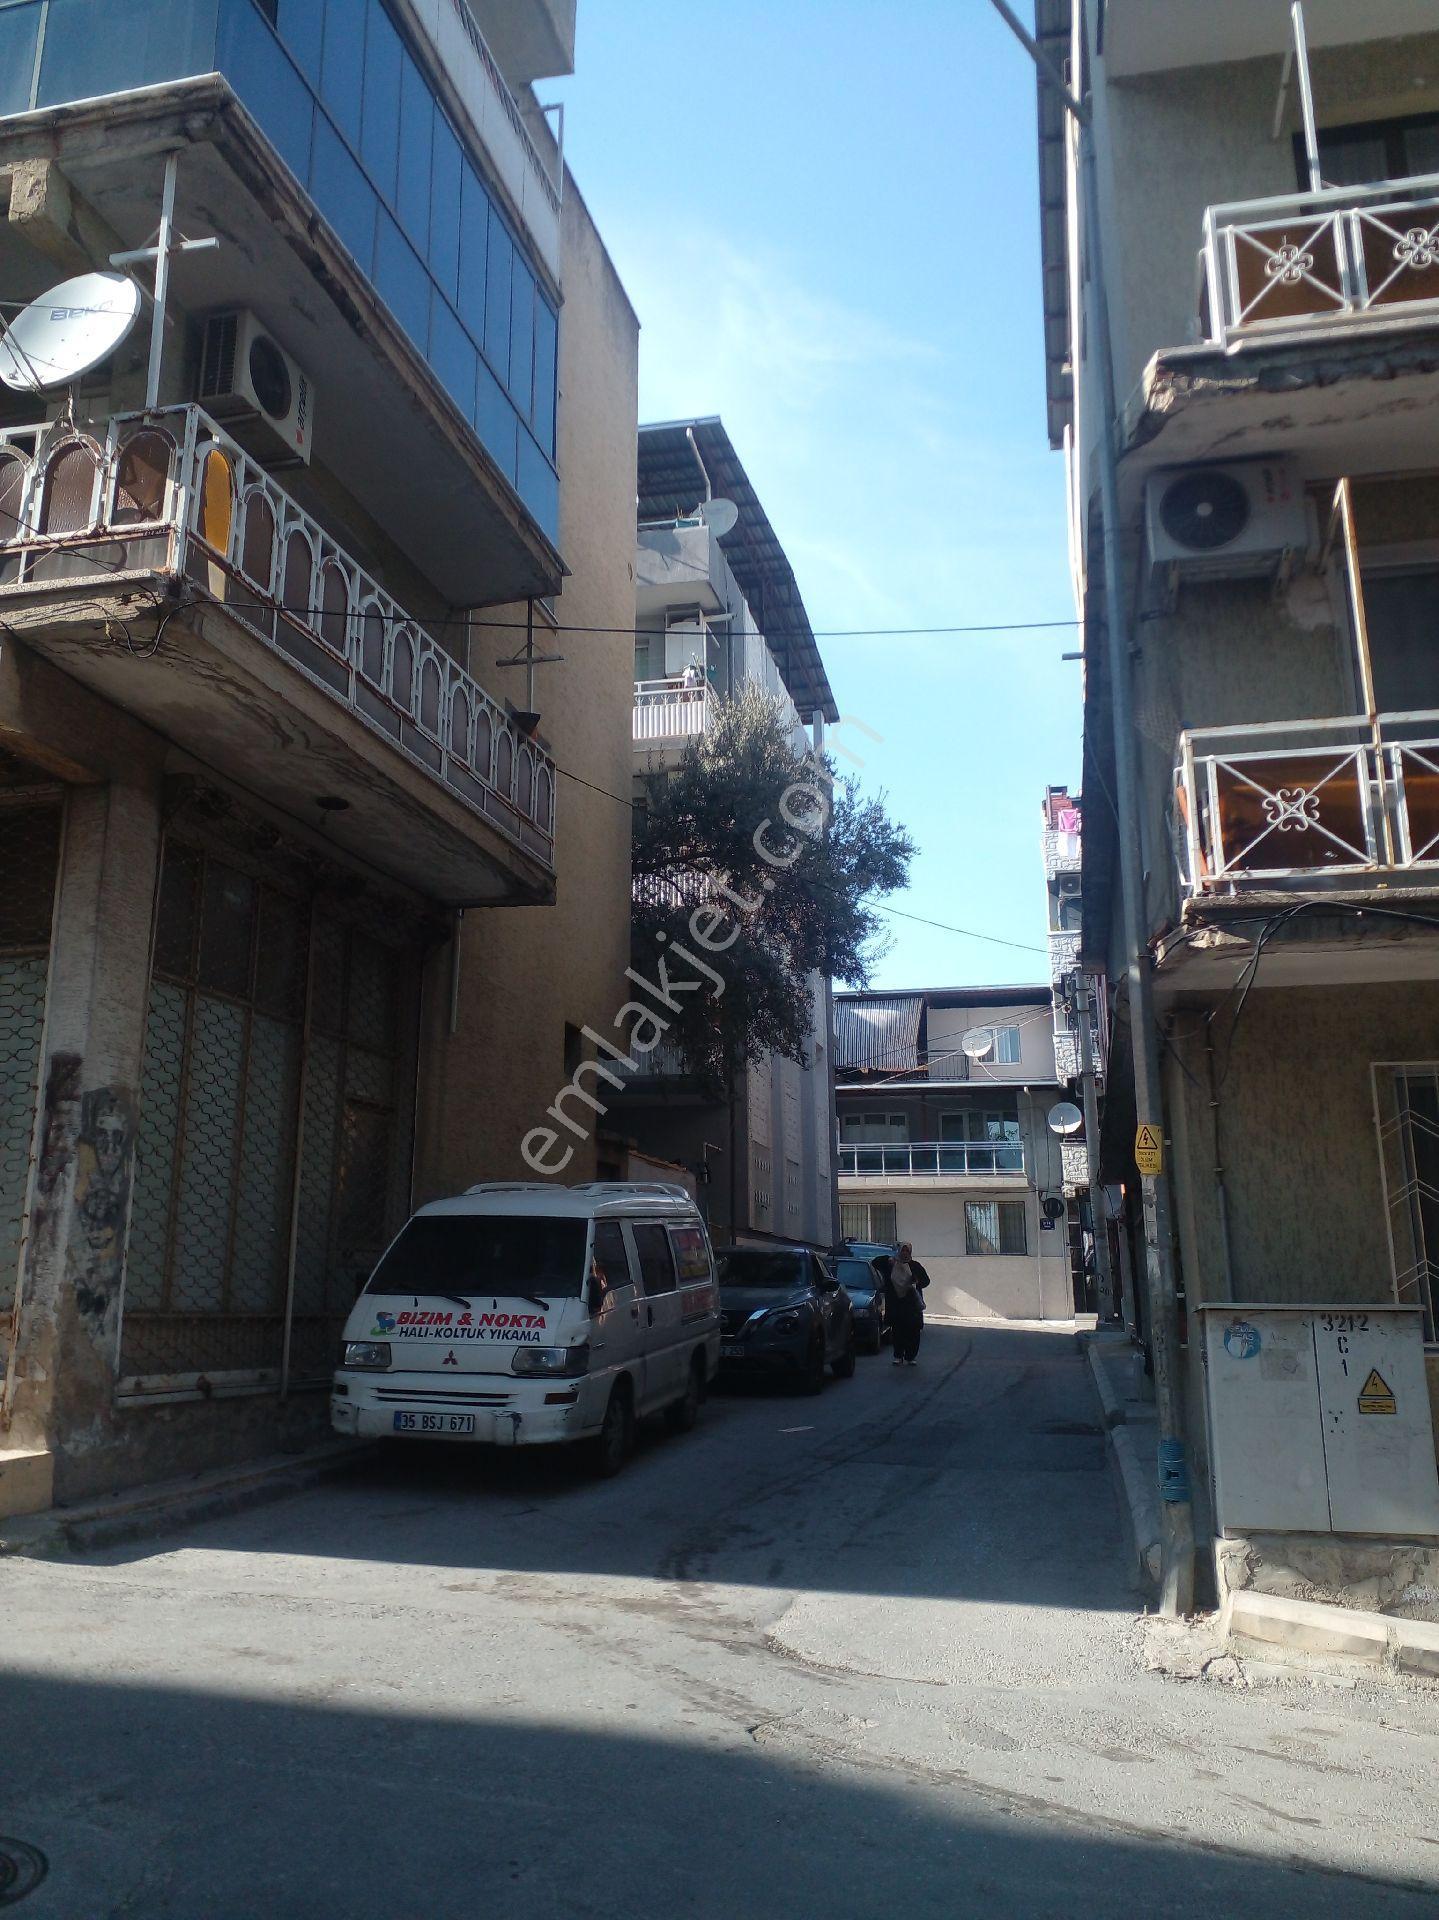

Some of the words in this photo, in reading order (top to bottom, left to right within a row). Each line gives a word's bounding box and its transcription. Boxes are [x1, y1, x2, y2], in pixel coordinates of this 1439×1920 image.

[457, 1312, 472, 1325] &
[479, 1313, 547, 1329] NOKTA
[1320, 1312, 1370, 1332] 3212
[399, 1326, 487, 1339] HALI-KOLTUK
[489, 1328, 542, 1342] YIKAMA
[401, 1414, 416, 1428] 35
[422, 1415, 444, 1430] BSJ
[450, 1416, 472, 1431] 671
